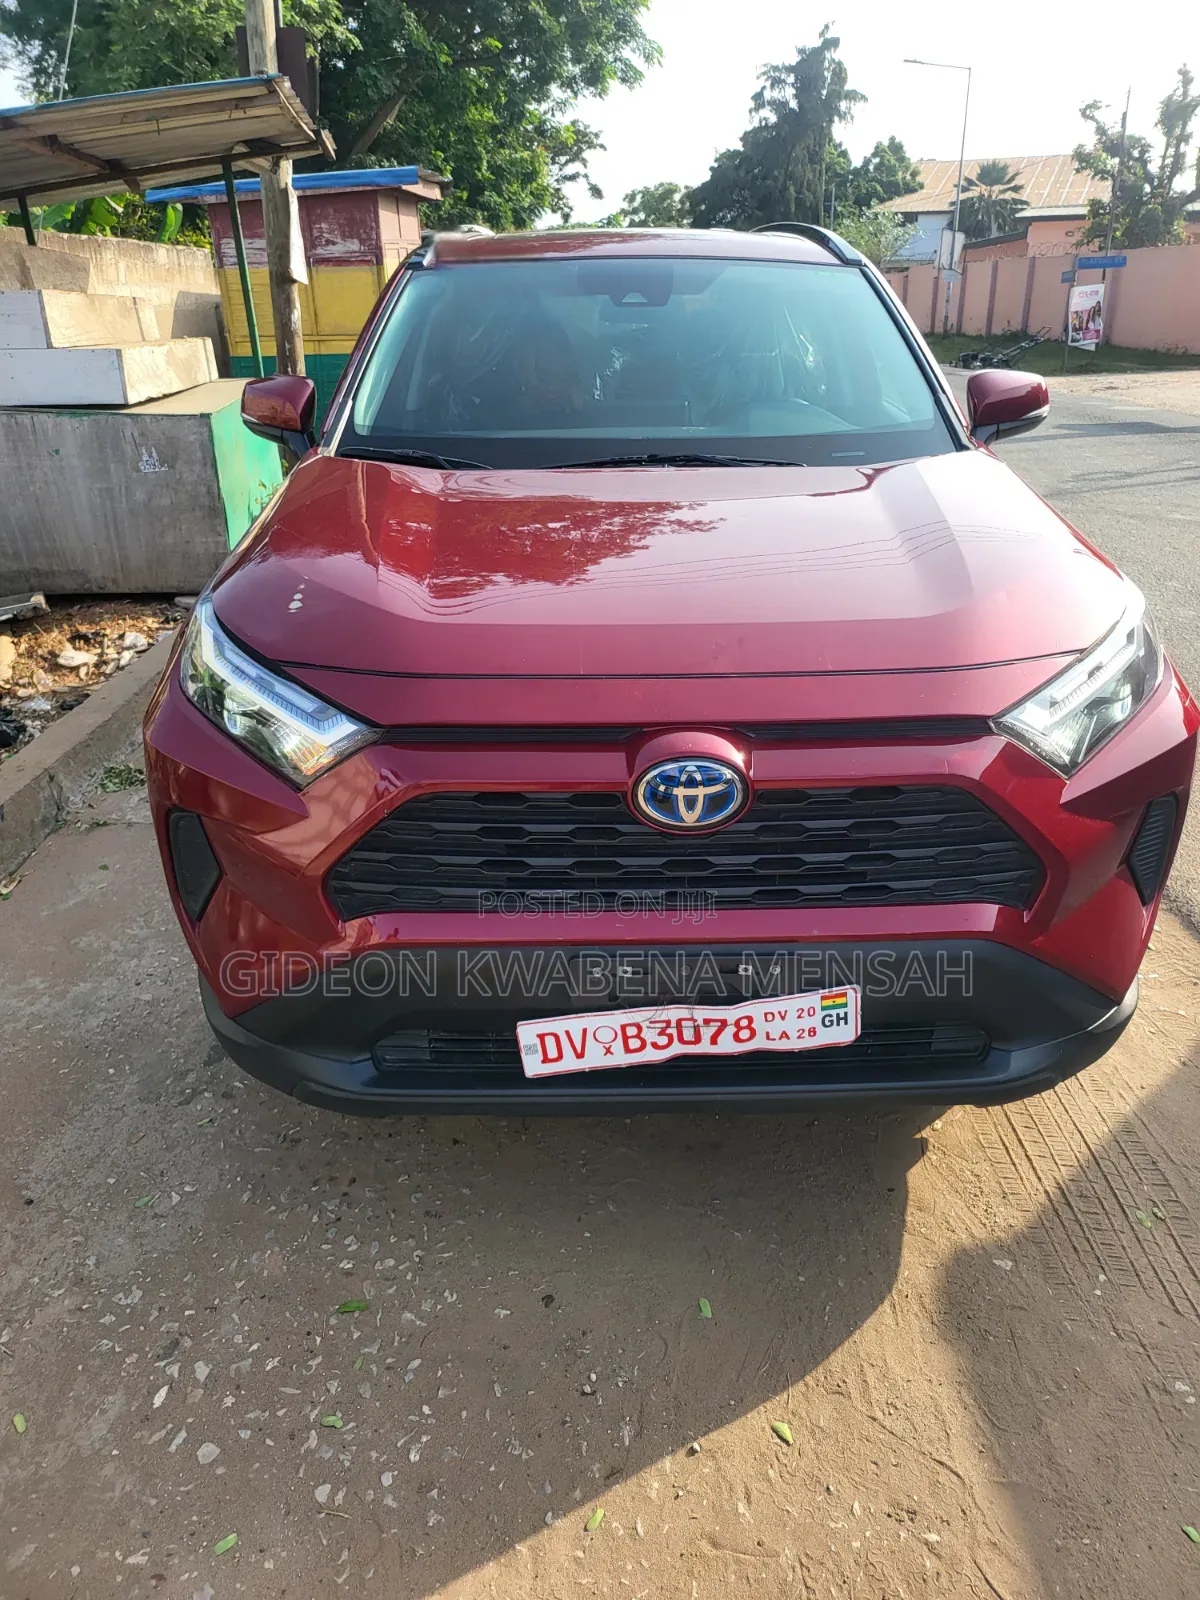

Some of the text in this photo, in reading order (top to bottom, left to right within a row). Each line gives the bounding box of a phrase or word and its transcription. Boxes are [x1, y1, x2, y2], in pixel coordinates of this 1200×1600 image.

[763, 1006, 816, 1023] DV 20
[821, 1011, 849, 1029] GH
[536, 1014, 757, 1064] DV B3078
[765, 1029, 791, 1041] LA
